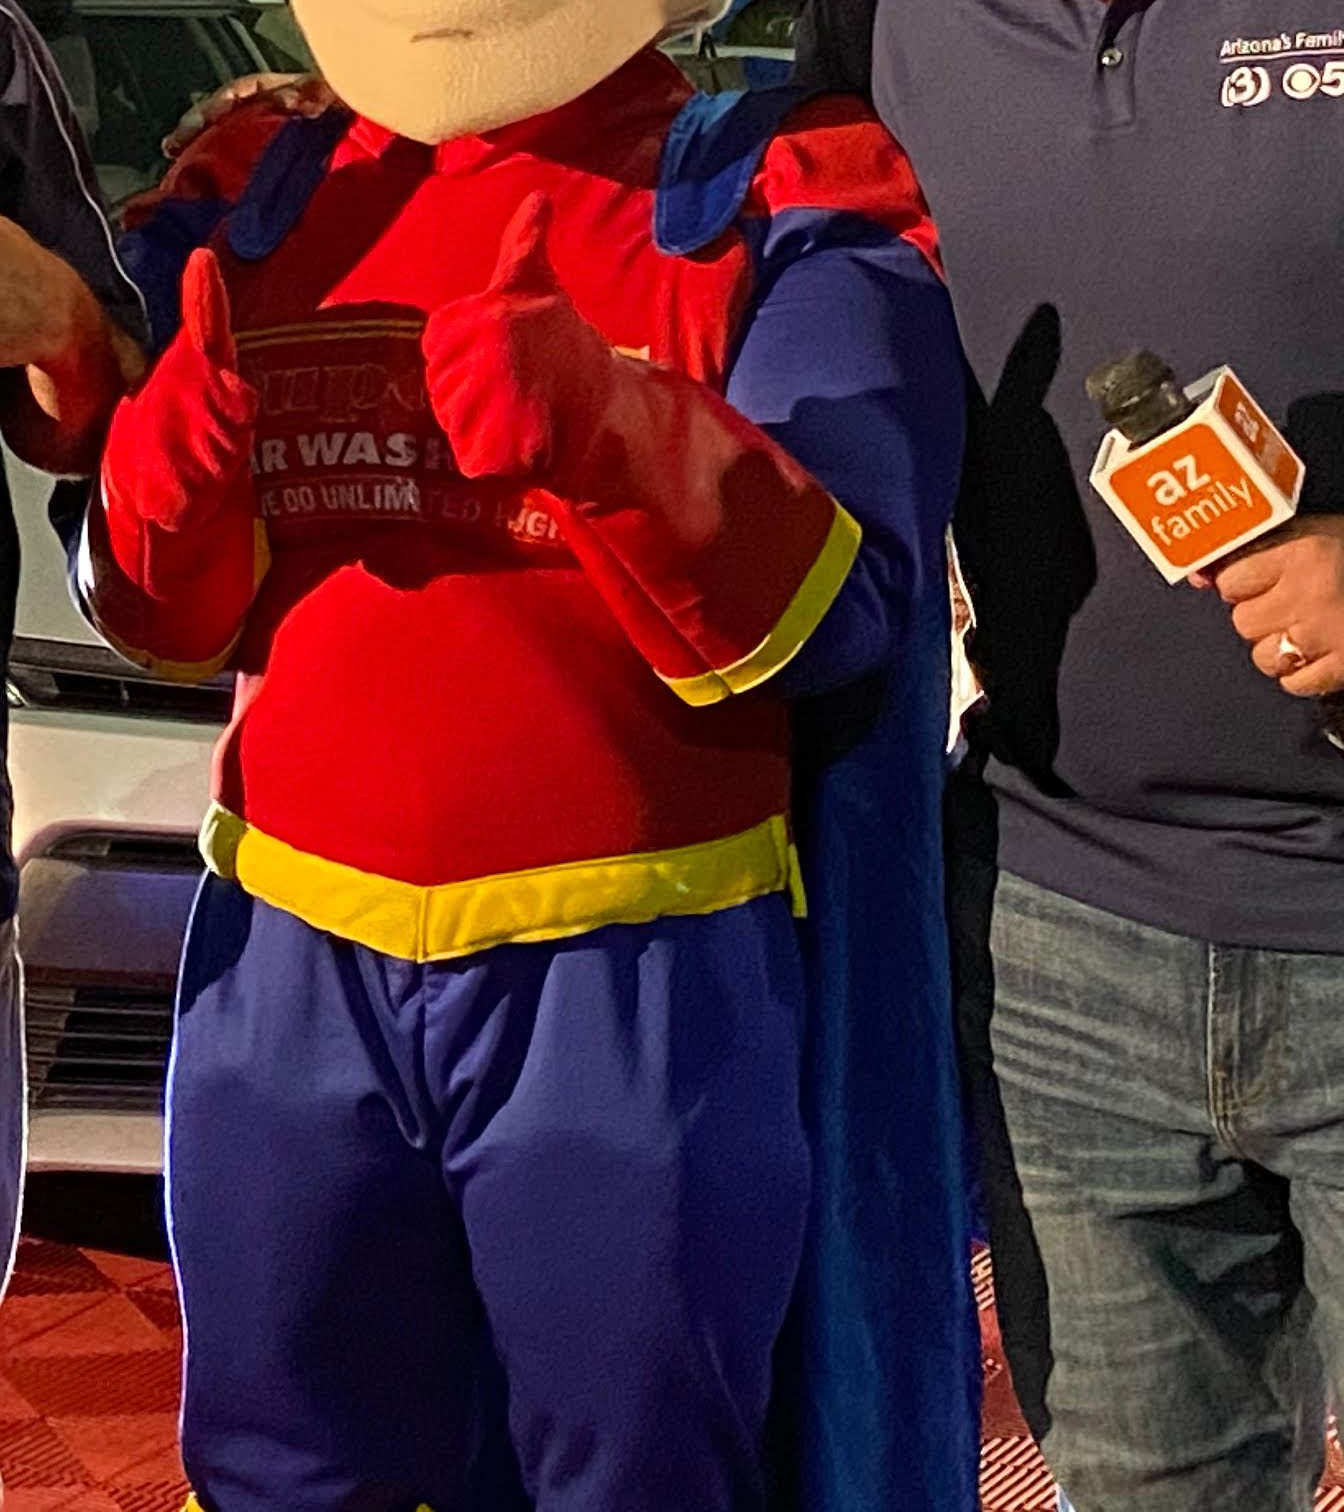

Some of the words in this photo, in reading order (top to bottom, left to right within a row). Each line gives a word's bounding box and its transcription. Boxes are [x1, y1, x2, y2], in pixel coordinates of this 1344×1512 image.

[1220, 33, 1291, 57] Arizona's
[284, 485, 316, 512] DO
[1146, 453, 1211, 506] az
[1151, 477, 1254, 547] family
